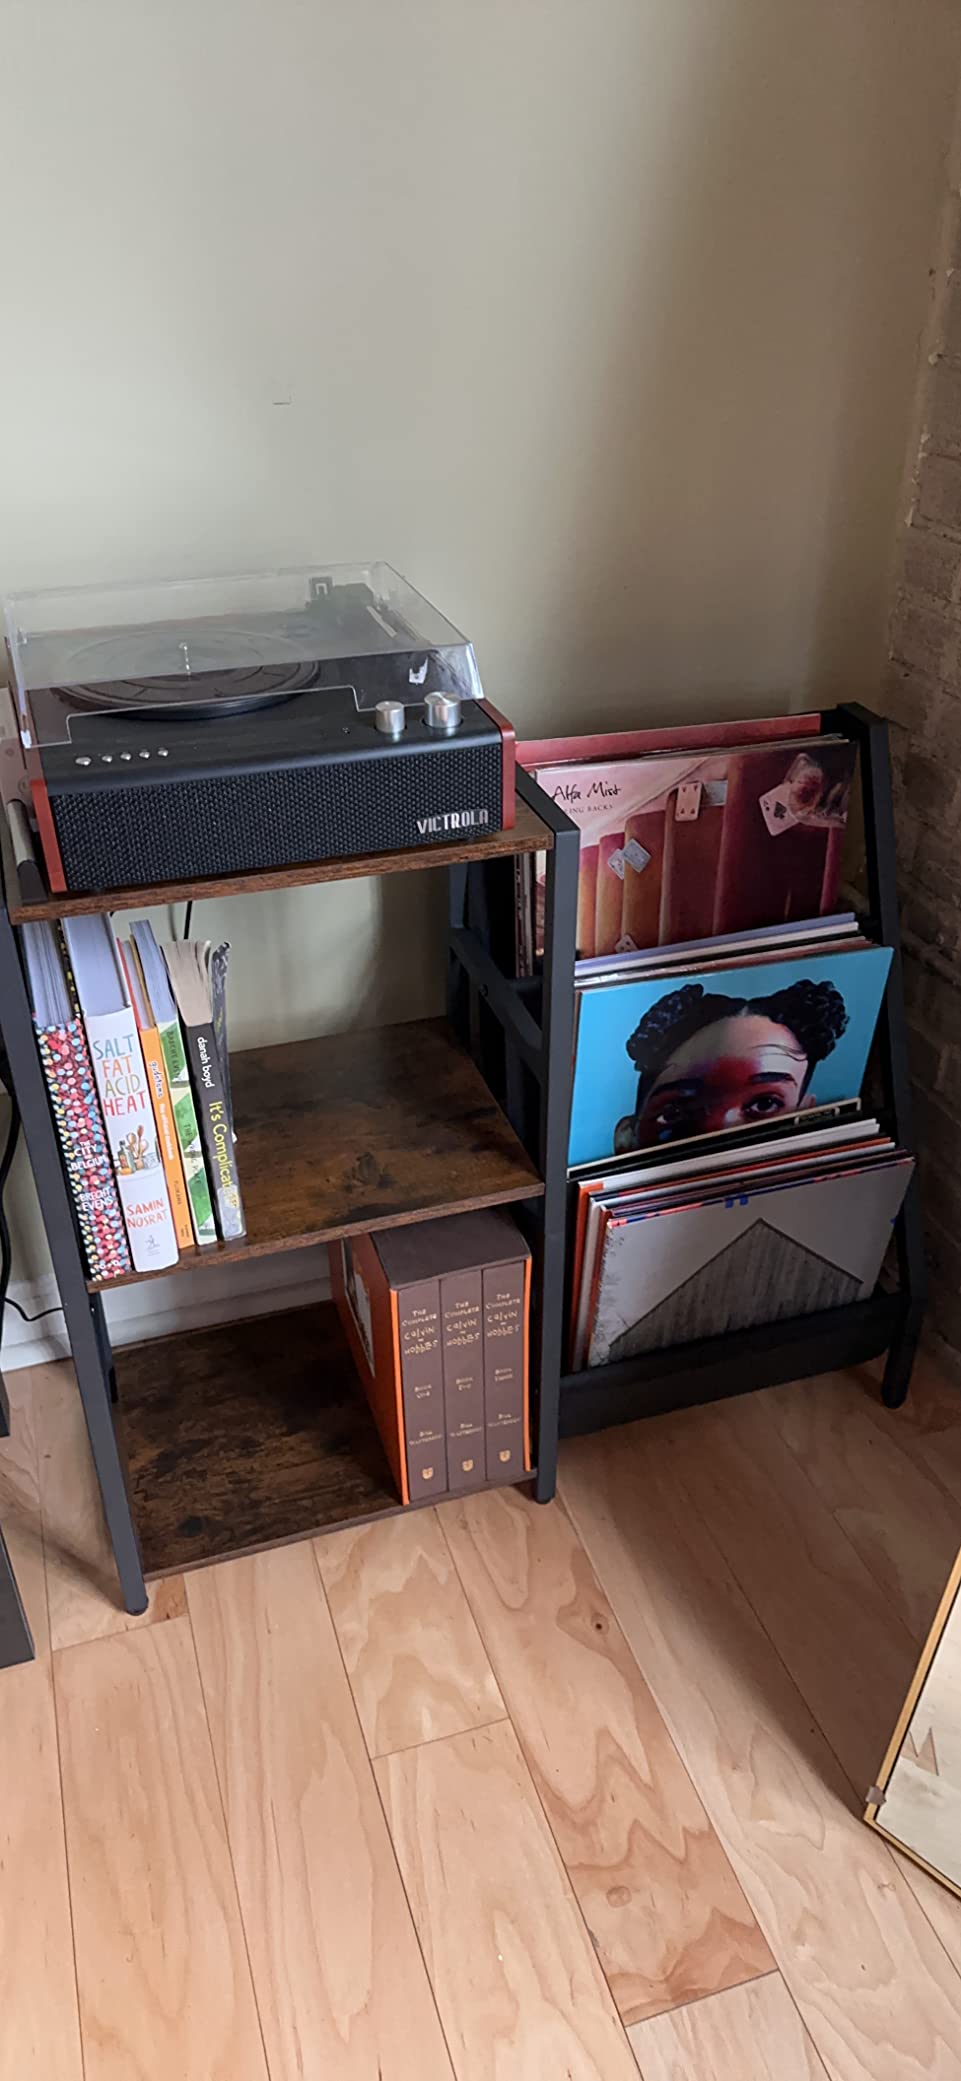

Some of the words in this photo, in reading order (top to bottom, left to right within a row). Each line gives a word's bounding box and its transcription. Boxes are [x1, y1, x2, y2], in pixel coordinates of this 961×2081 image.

[552, 783, 582, 804] Alfa
[586, 781, 622, 798] Mist
[416, 808, 489, 834] VICTROLA
[92, 1033, 134, 1060] SALT
[197, 1036, 211, 1065] danah
[101, 1054, 131, 1078] FAT
[201, 1064, 216, 1088] boyd
[104, 1073, 141, 1098] ACID
[102, 1090, 146, 1117] HEAT
[209, 1101, 224, 1122] It's
[74, 1143, 98, 1157] CITY
[126, 1197, 165, 1216] SAMIN
[126, 1208, 169, 1229] NOSRAT
